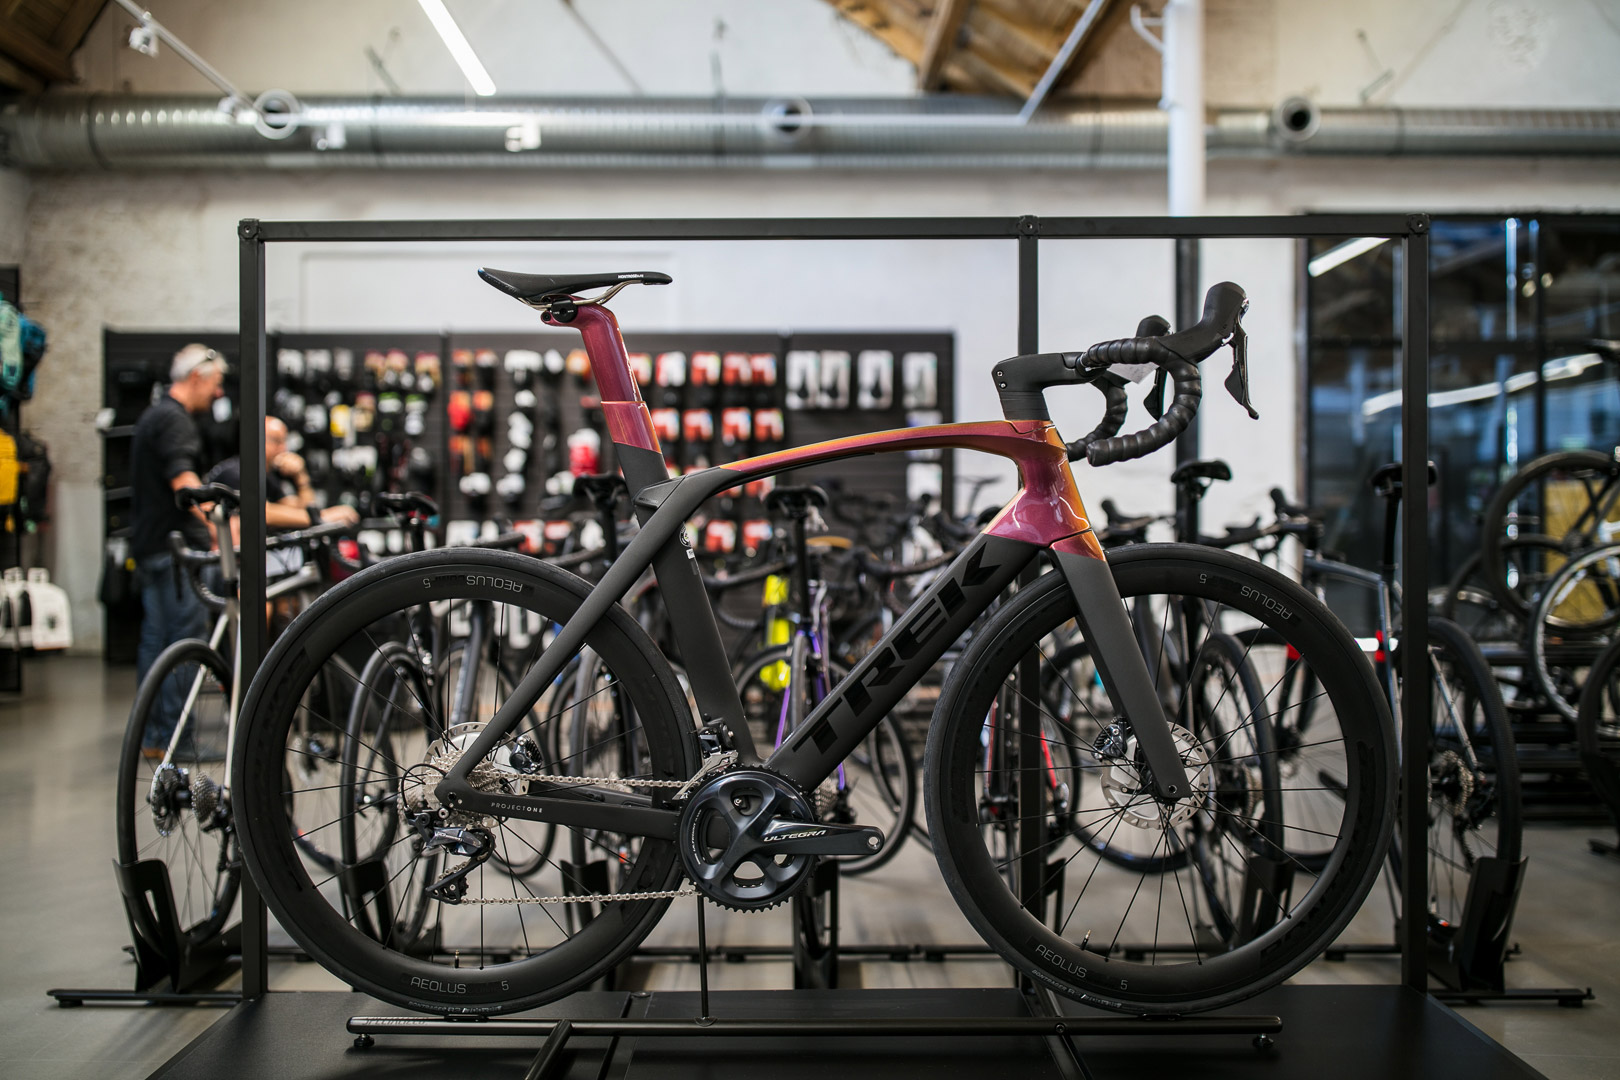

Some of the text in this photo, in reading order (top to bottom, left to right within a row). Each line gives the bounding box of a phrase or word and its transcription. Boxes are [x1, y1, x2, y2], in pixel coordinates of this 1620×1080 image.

[423, 578, 431, 588] 5
[466, 575, 523, 592] AEOLUS
[1199, 573, 1207, 584] 5
[1241, 586, 1293, 619] AEOLUS
[792, 541, 1002, 755] TREK
[763, 829, 826, 842] ULTEGRA
[1035, 944, 1128, 990] AEOLUS 5
[410, 976, 467, 994] AEOLUS
[501, 980, 510, 991] 5
